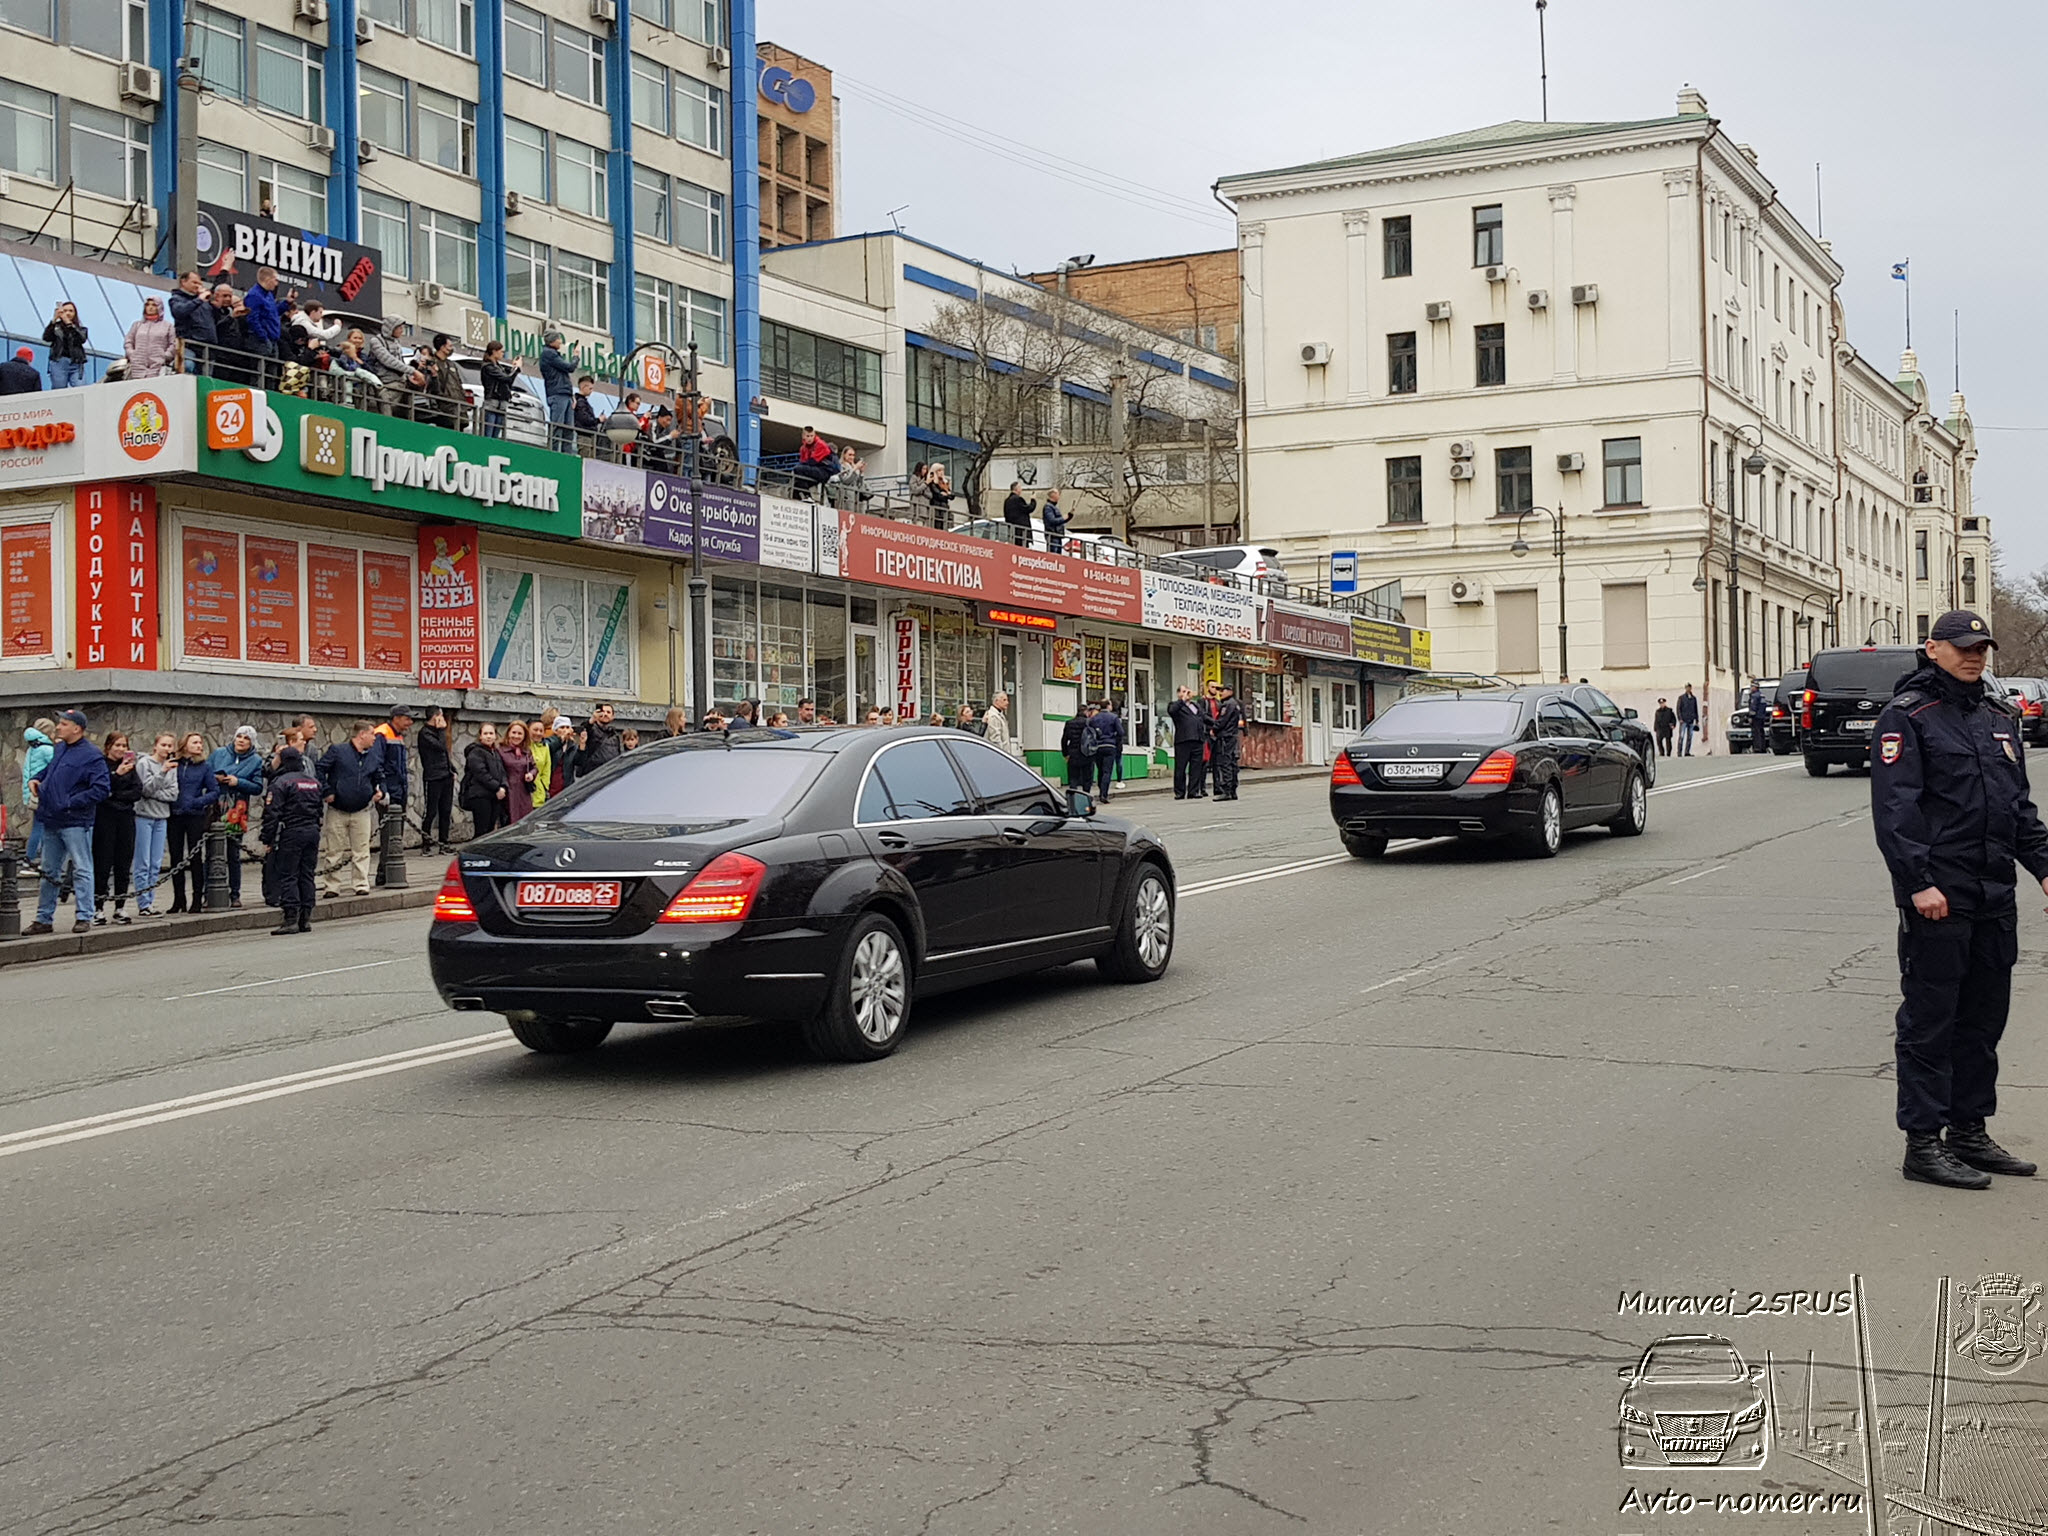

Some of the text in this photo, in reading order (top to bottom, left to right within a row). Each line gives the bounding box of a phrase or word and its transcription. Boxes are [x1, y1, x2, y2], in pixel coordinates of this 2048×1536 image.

[234, 223, 343, 284] ВИНИЛ
[650, 367, 659, 381] 24
[23, 409, 53, 420] МИРА
[220, 409, 240, 429] 24
[122, 431, 166, 447] Honey
[1, 456, 43, 468] РОССИИ
[351, 427, 559, 512] ПримСоцБанк
[670, 495, 757, 528] Окенрыбфлот
[710, 535, 742, 553] Служба
[89, 491, 105, 663] ПРОДУКТЫ
[129, 491, 145, 663] НАПИТКИ
[876, 548, 983, 590] ПЕРСПЕКТИВА
[421, 586, 474, 609] BEER
[1210, 604, 1242, 619] КАДАСТР
[421, 616, 474, 628] ПЕННЫЕ
[1164, 613, 1206, 633] 2-667-645
[1217, 622, 1252, 640] 2-511-645
[421, 627, 474, 639] НАПИТКИ
[421, 644, 474, 654] ПРОДУКТЫ
[421, 660, 474, 669] СО ВСЕГО
[895, 619, 915, 719] ФРУКТЫ
[421, 669, 473, 685] МИРА
[1427, 764, 1440, 774] 125
[523, 883, 615, 903] 087D088 25
